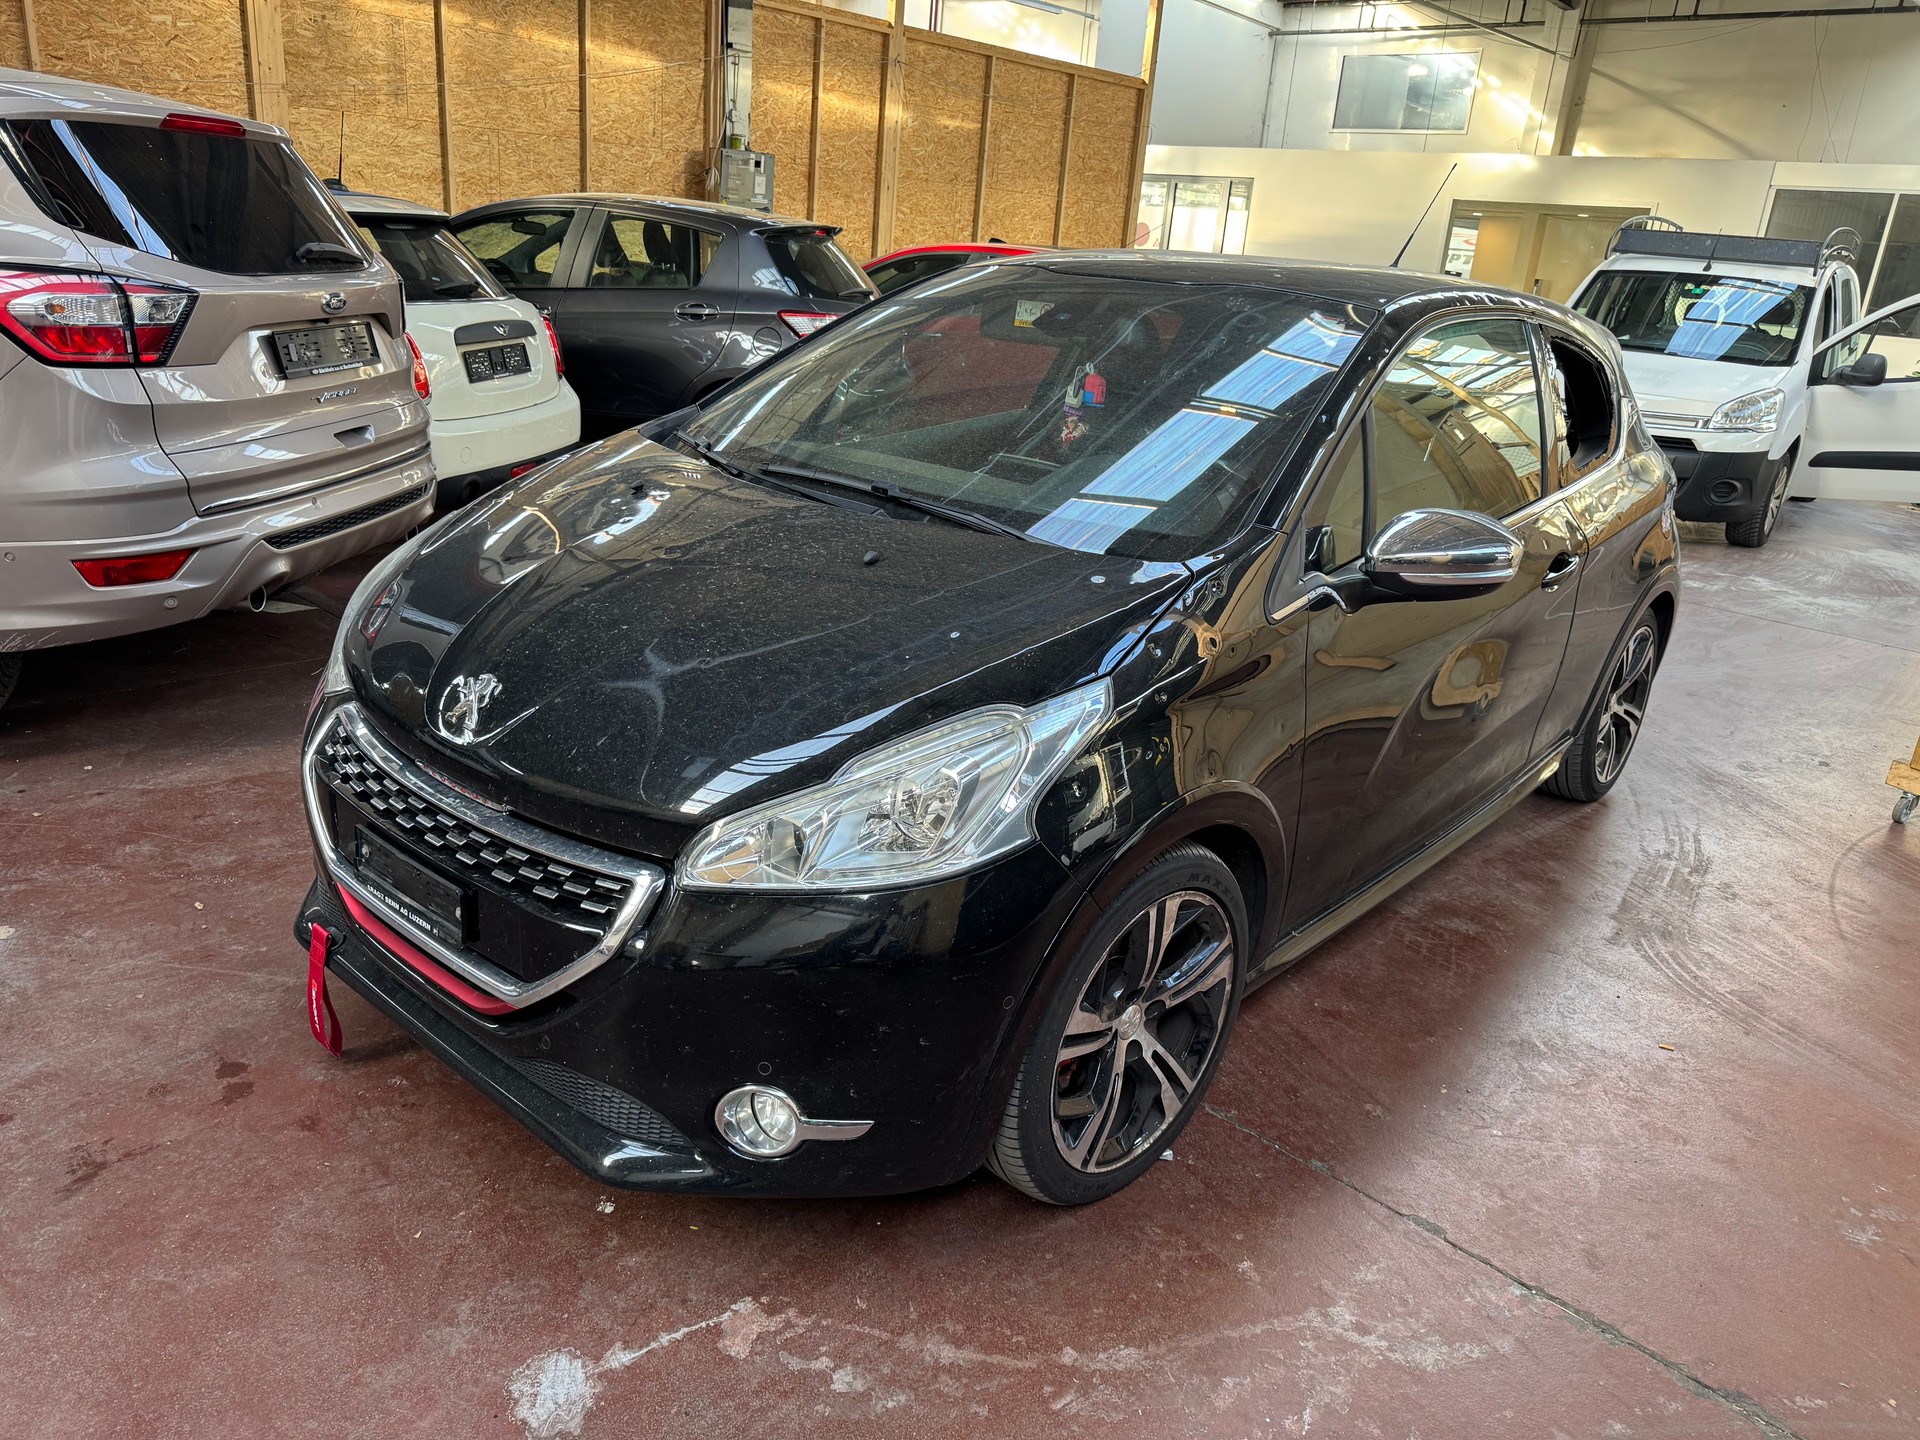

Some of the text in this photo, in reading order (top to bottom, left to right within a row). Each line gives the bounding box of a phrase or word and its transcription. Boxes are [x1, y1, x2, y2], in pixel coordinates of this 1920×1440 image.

[384, 896, 400, 911] SENN
[400, 906, 408, 916] AG
[408, 911, 431, 931] LUZERN
